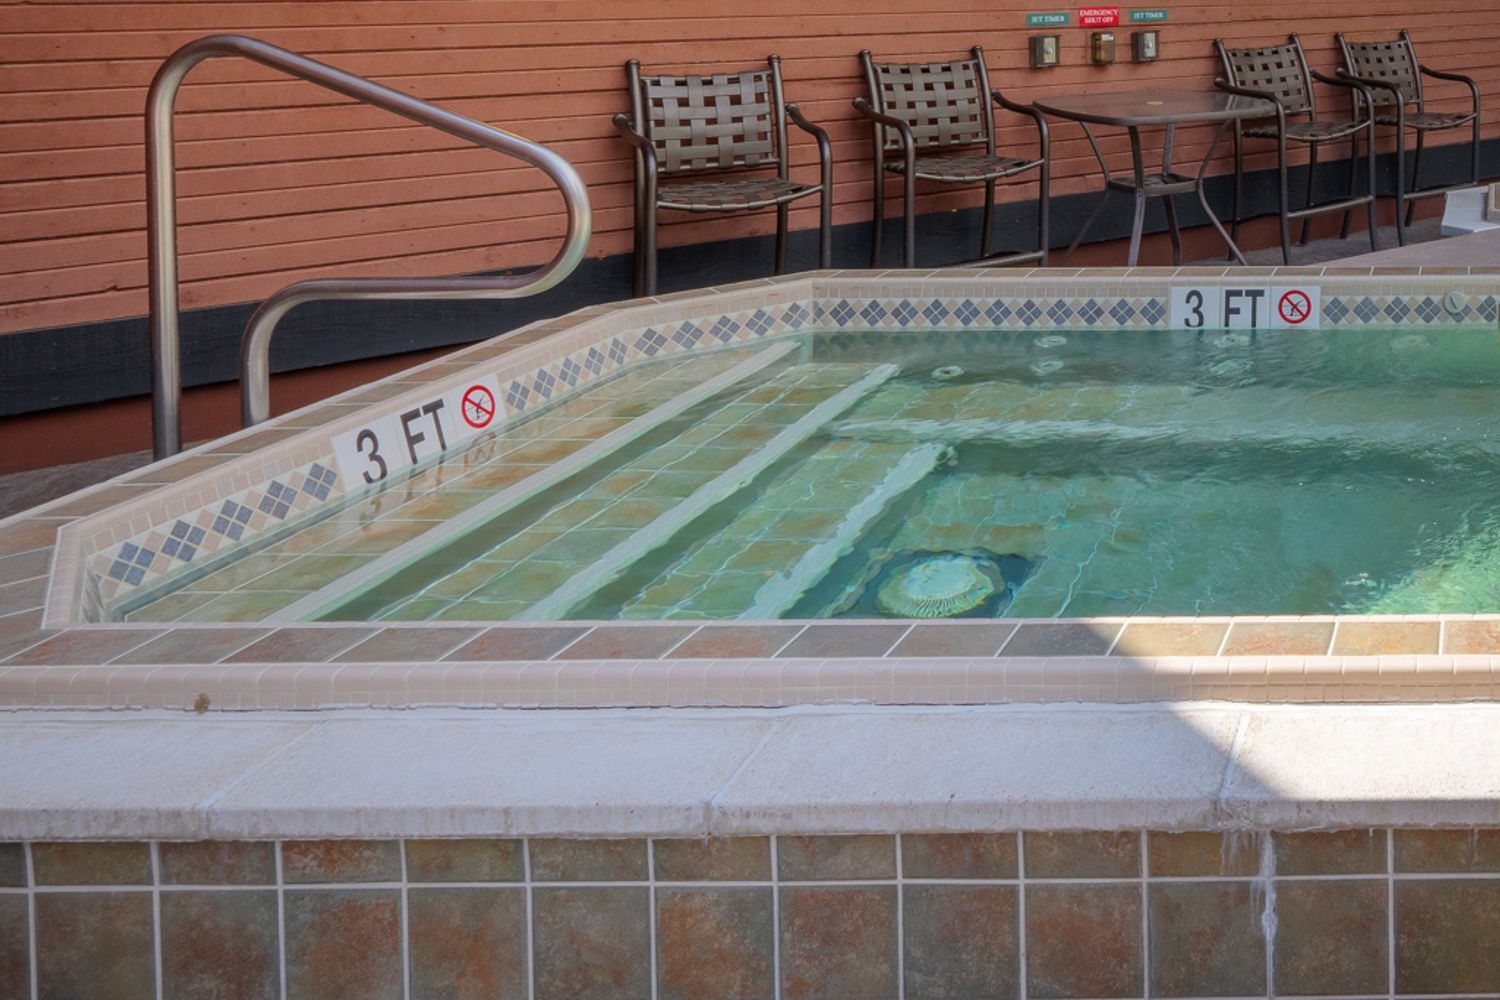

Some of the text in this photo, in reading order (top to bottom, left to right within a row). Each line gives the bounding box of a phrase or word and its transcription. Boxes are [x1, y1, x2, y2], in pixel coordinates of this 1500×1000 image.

[1080, 8, 1118, 17] EMERGENCY
[1133, 11, 1164, 20] JET TIMER
[1045, 14, 1065, 22] TIMER
[1084, 16, 1101, 24] SHUT
[1184, 289, 1265, 328] 3 FT
[356, 398, 447, 484] 3 FT
